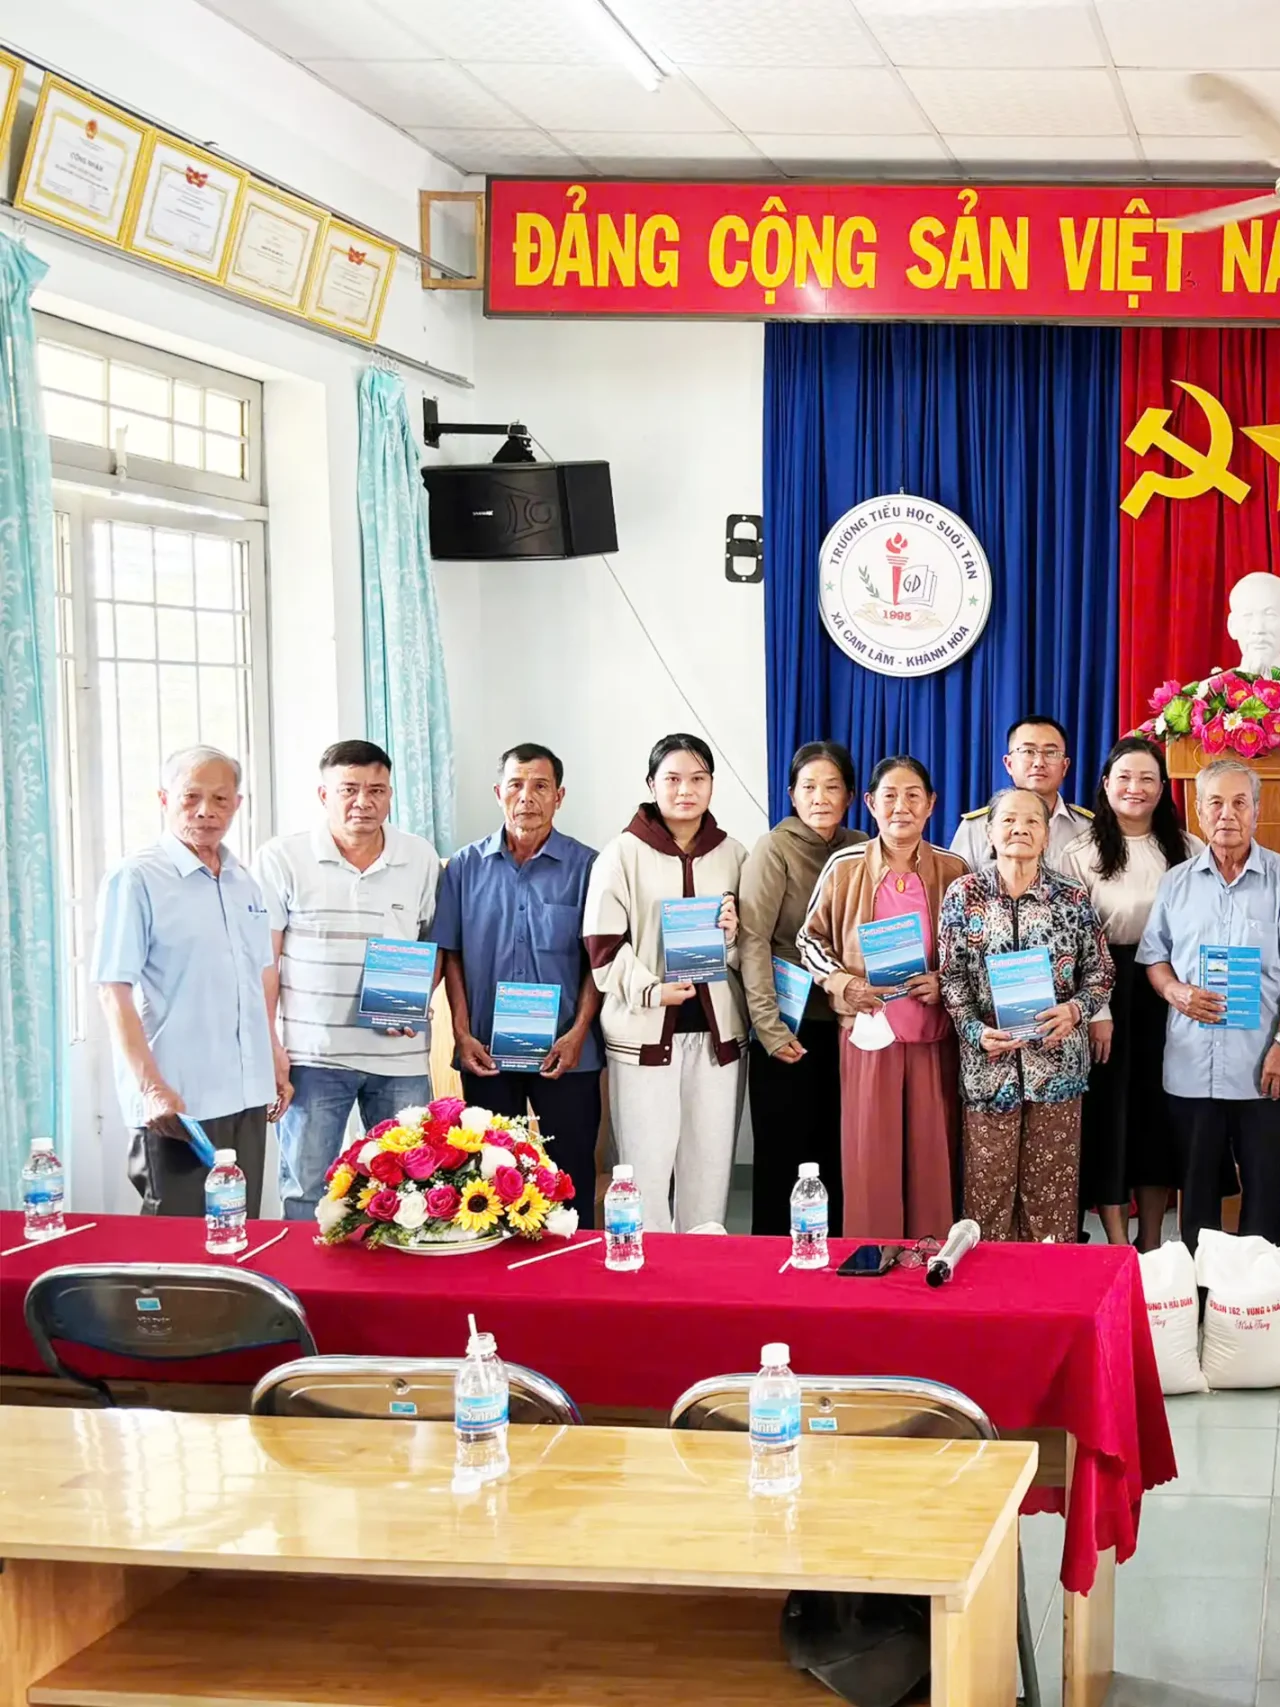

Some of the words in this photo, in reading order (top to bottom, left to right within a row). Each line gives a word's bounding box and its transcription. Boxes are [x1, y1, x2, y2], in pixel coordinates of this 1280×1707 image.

[513, 185, 681, 288] ĐẢNG
[708, 196, 878, 305] CỘNG
[906, 188, 1029, 290] SẢN
[1060, 198, 1194, 308] VIỆT
[869, 501, 901, 523] TIỂU
[906, 506, 935, 524] HỌC
[843, 629, 867, 654] CAM
[867, 647, 895, 667] LÂM
[906, 645, 948, 668] KHÁNH
